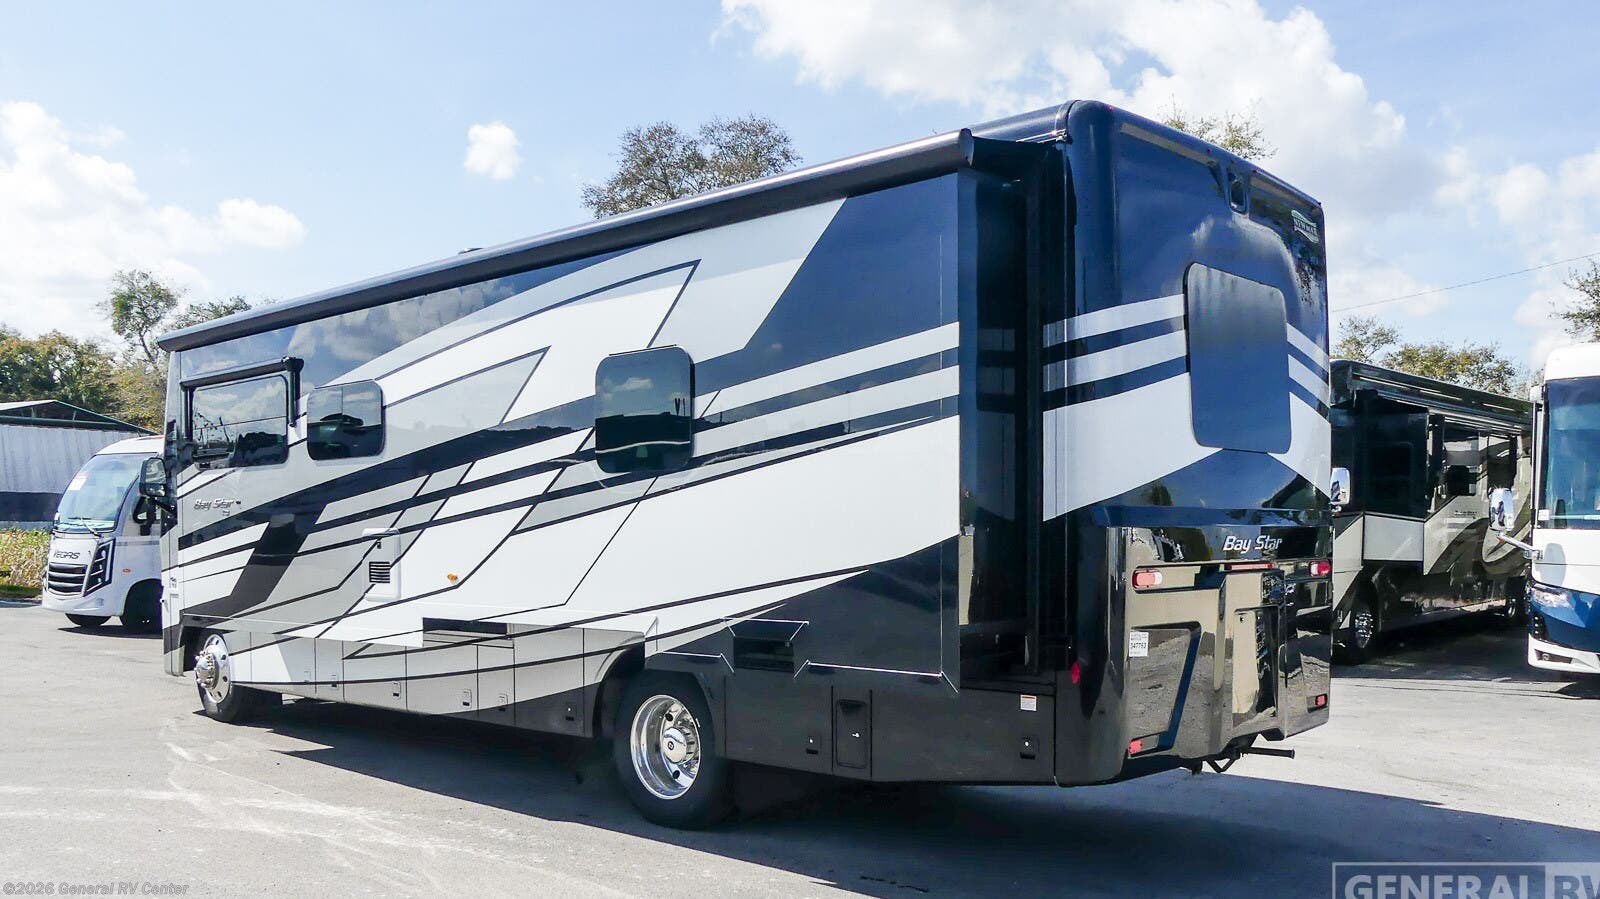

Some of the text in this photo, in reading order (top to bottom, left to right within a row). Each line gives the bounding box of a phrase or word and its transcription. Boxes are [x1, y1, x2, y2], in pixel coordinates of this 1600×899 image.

[1223, 535, 1283, 554] Bay Star
[54, 551, 81, 560] VEGAS
